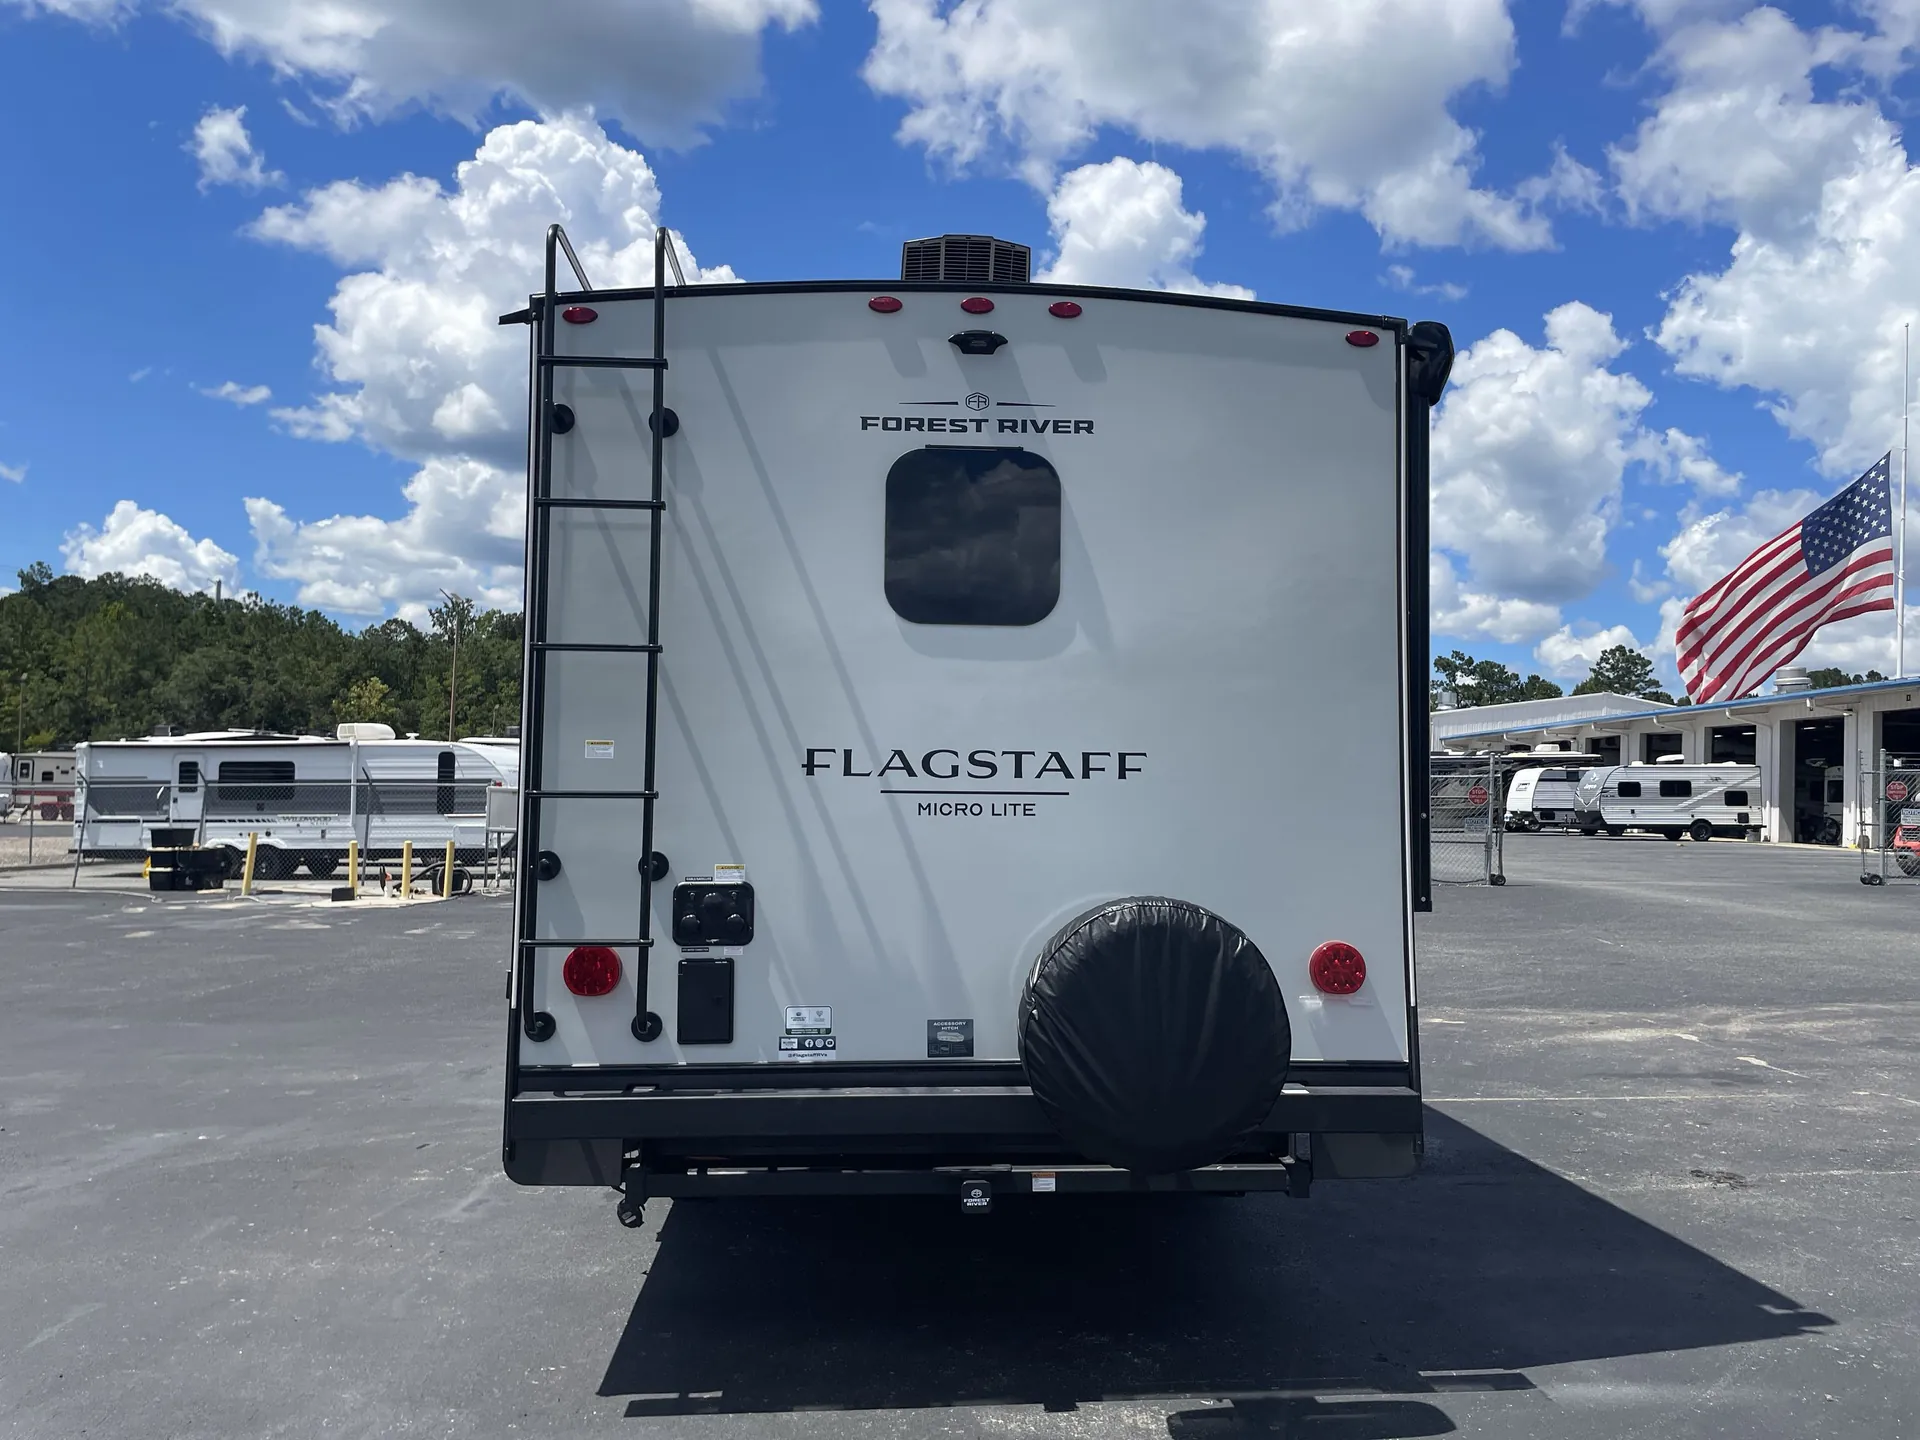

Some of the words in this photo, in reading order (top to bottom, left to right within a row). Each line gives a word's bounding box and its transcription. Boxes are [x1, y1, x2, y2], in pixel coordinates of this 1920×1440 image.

[860, 415, 989, 433] FOREST
[996, 418, 1095, 435] RIVER
[801, 747, 1148, 780] FLAGSTAFF
[917, 802, 983, 817] MICRO
[991, 803, 1036, 817] LITE
